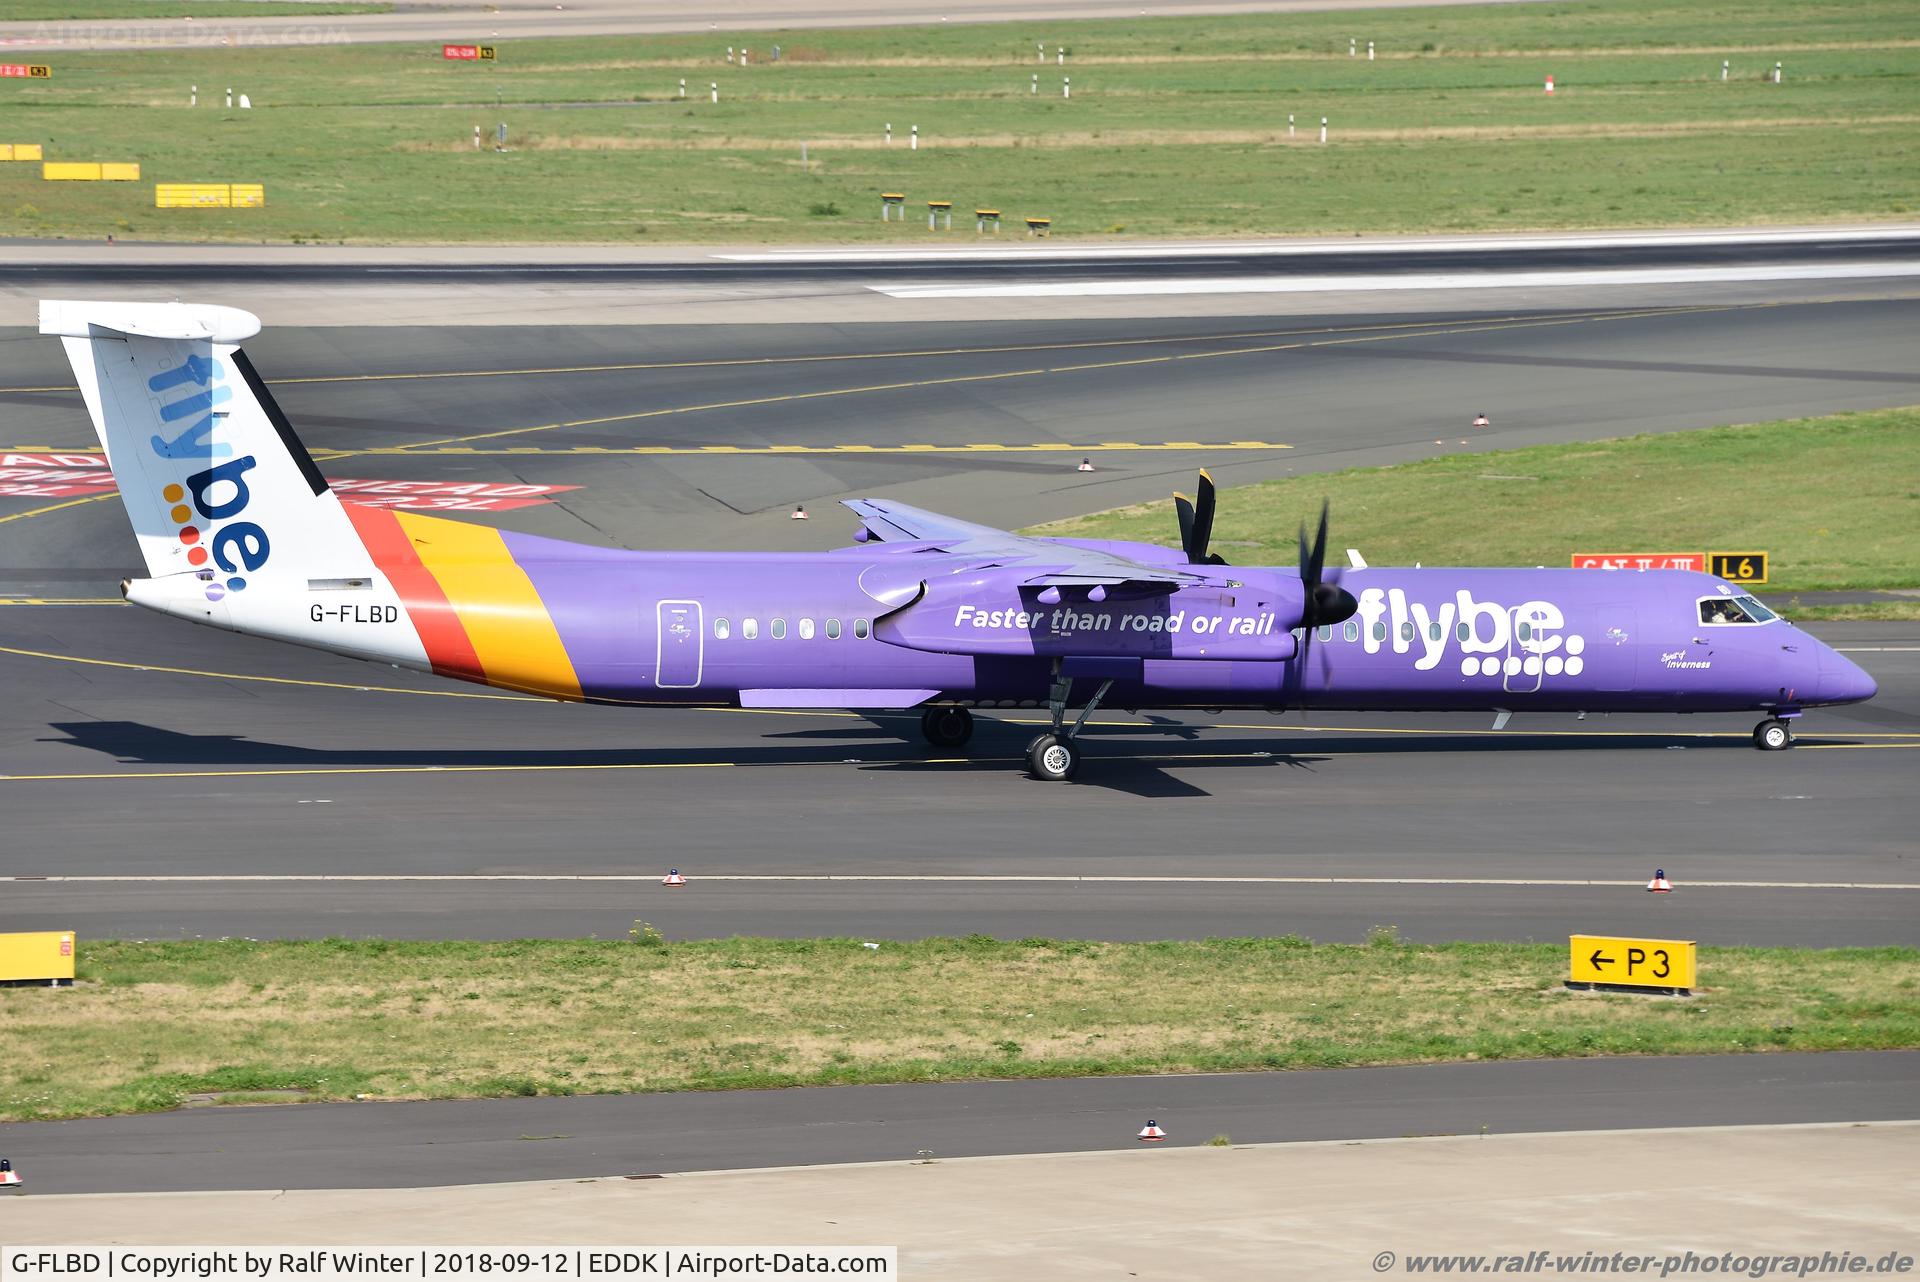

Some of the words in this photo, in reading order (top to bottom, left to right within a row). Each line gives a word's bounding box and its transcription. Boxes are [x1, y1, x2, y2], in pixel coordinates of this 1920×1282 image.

[1721, 558, 1754, 579] L6
[310, 604, 398, 623] G-FLBD
[954, 604, 1044, 629] Faster
[1051, 606, 1112, 632] than
[1120, 609, 1185, 634] road
[1191, 615, 1224, 634] or
[1228, 612, 1276, 637] rail
[1667, 659, 1711, 669] Inverness
[1628, 948, 1670, 978] P3
